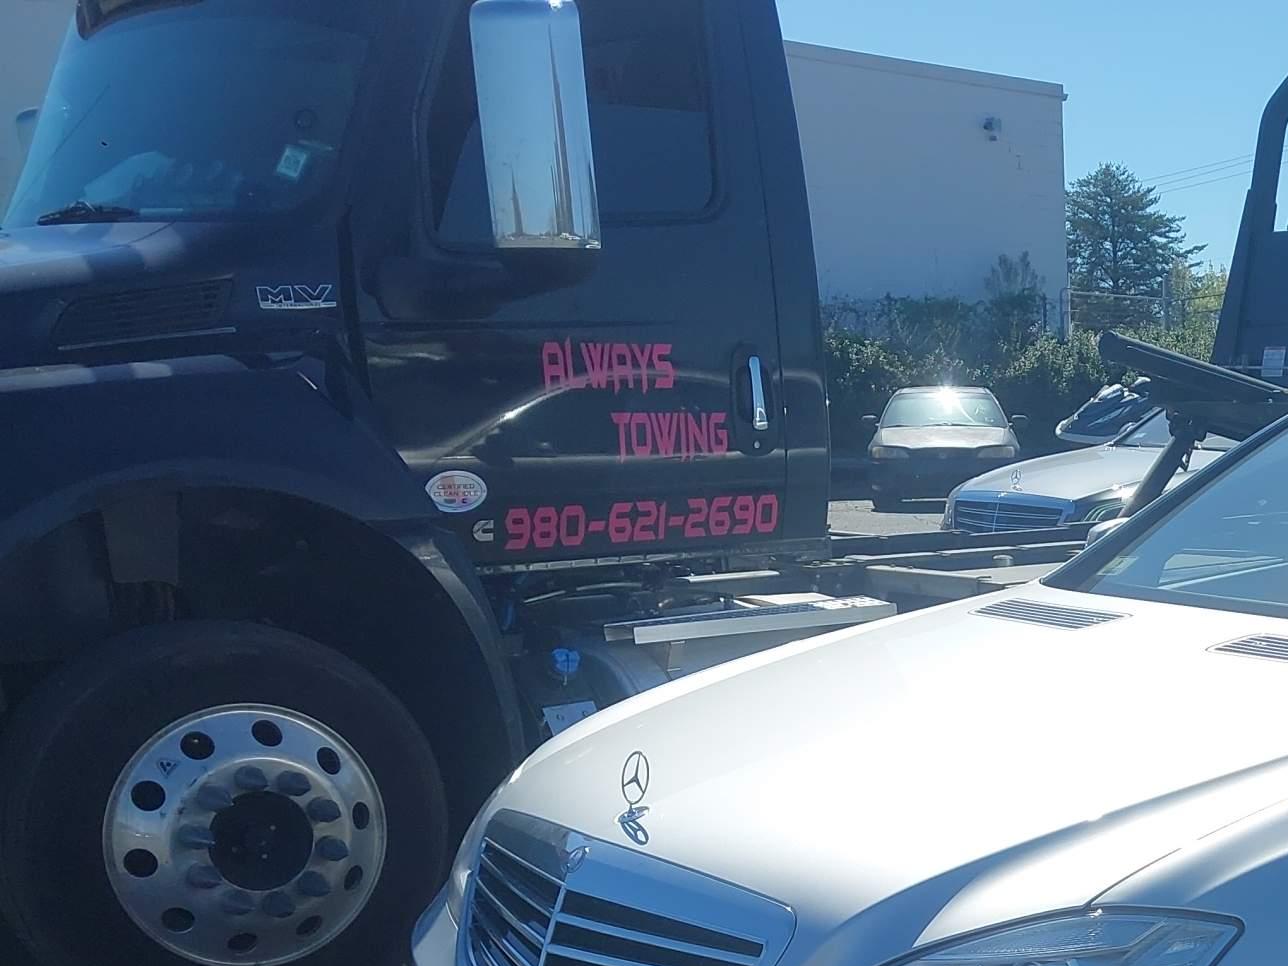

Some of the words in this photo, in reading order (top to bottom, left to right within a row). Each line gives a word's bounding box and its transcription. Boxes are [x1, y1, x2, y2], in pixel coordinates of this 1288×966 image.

[256, 284, 332, 303] MV
[541, 336, 677, 394] ALWAYS
[610, 411, 728, 464] TOWING
[504, 494, 778, 550] 980-621-2690
